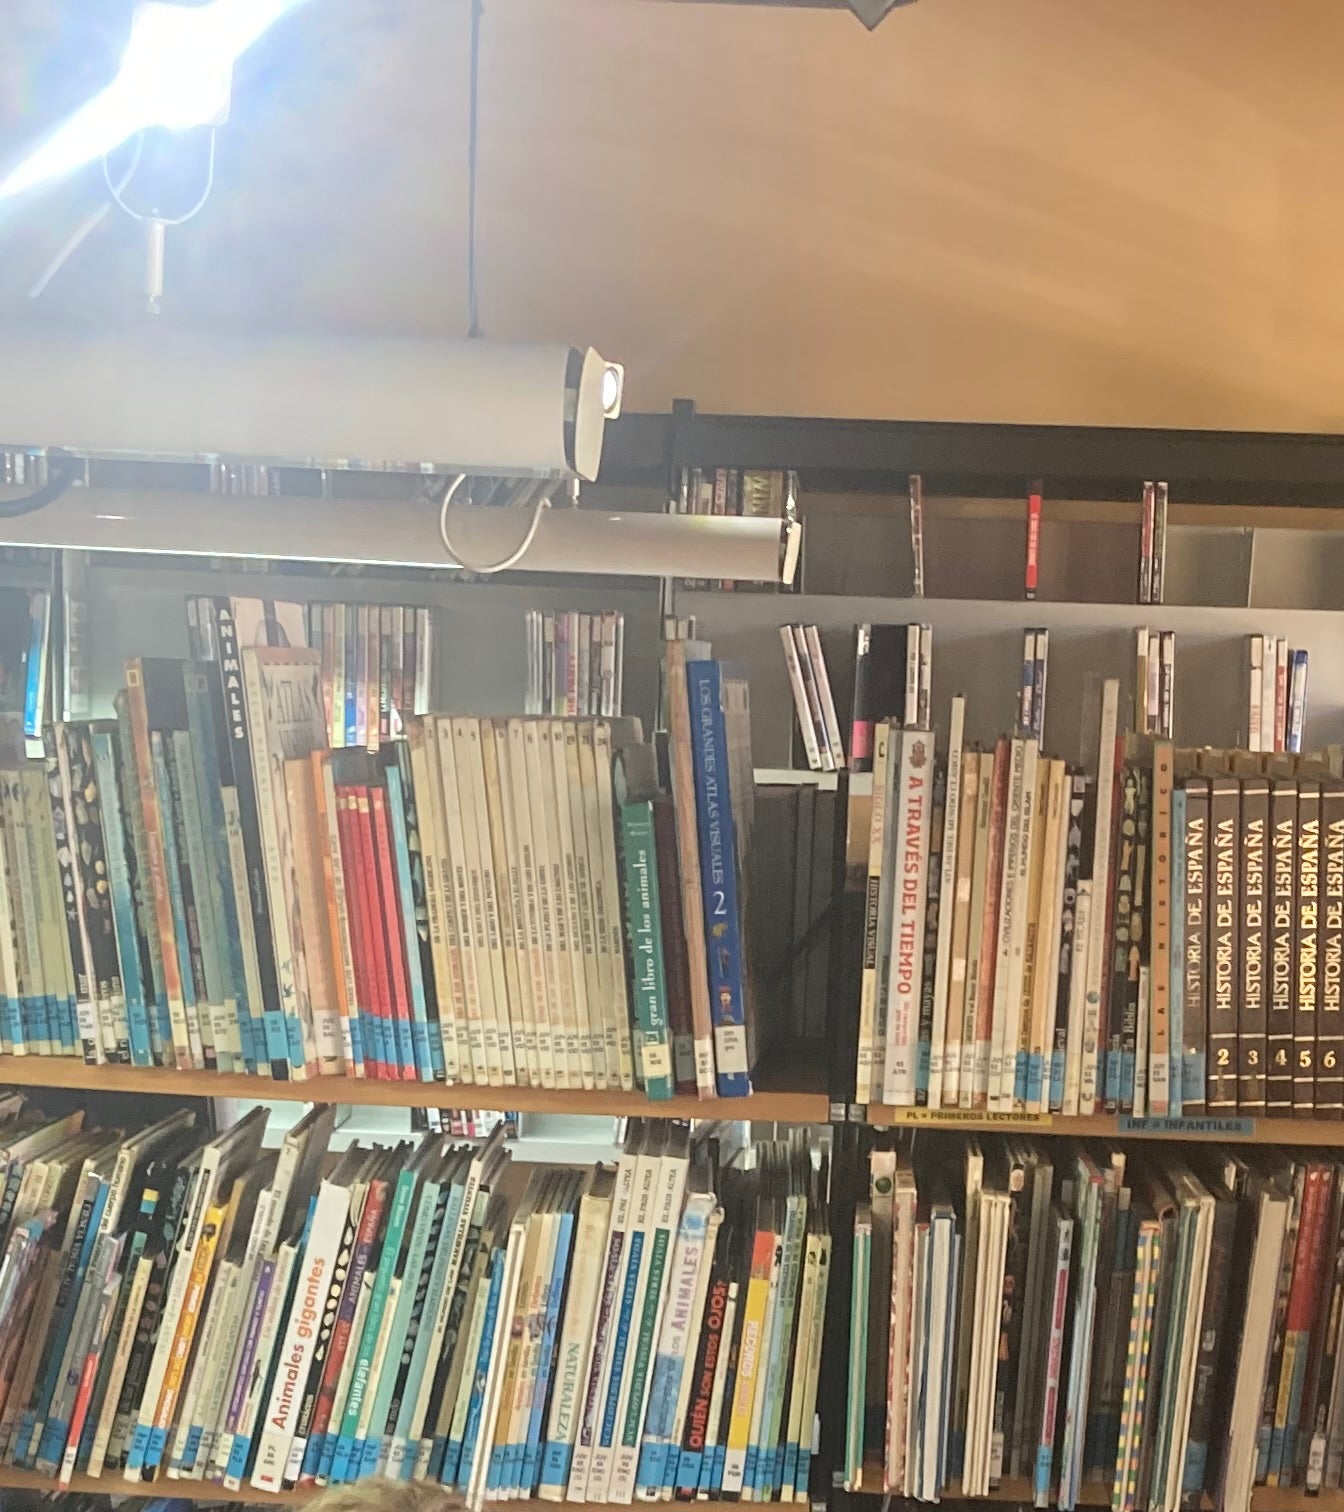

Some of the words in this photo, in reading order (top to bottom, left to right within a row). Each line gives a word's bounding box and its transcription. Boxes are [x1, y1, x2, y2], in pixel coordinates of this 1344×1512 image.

[218, 608, 245, 741] ANIMALES
[696, 677, 711, 705] LOS
[703, 774, 722, 820] ATLAS
[906, 775, 923, 791] A
[901, 794, 926, 874] TRAVÉS
[1182, 815, 1203, 895] ESPAÑA
[1213, 818, 1233, 896] ESPAÑA
[1243, 818, 1263, 896] ESPAÑA
[1271, 817, 1292, 897] ESPAÑA
[1297, 818, 1318, 898] ESPAÑA
[1322, 817, 1344, 898] ESPAÑA
[632, 847, 652, 909] animales
[899, 877, 918, 916] DEL
[712, 890, 727, 915] 2
[1185, 897, 1203, 926] DE
[1216, 900, 1233, 927] DE
[1246, 900, 1263, 927] DE
[1273, 899, 1292, 928] DE
[1299, 901, 1318, 930] DE
[1325, 901, 1343, 930] DE
[636, 912, 653, 933] los
[638, 936, 654, 954] de
[896, 920, 915, 995] TIEMPO
[638, 957, 657, 990] libro
[1216, 931, 1233, 1009] HISTORIA
[1246, 931, 1263, 1009] HISTORIA
[1273, 930, 1291, 1010] HISTORIA
[1299, 932, 1317, 1012] HISTORIA
[1324, 932, 1343, 1012] HISTORIA
[645, 994, 664, 1027] gran
[1218, 1049, 1230, 1065] 2
[1247, 1049, 1259, 1066] 3
[1275, 1049, 1288, 1066] 4
[1299, 1050, 1312, 1068] 5
[1323, 1051, 1336, 1068] 6
[906, 1111, 920, 1120] PL
[930, 1111, 984, 1121] PRIMEROS
[986, 1112, 1039, 1122] LECTORES
[1127, 1119, 1151, 1130] INF
[1164, 1119, 1242, 1132] INFANTILES
[663, 1244, 706, 1332] ANIMALES
[265, 1340, 309, 1430] Animales
[289, 1254, 333, 1341] gigantes
[344, 1356, 373, 1418] elefantes
[553, 1340, 582, 1442] NATURALEZA
